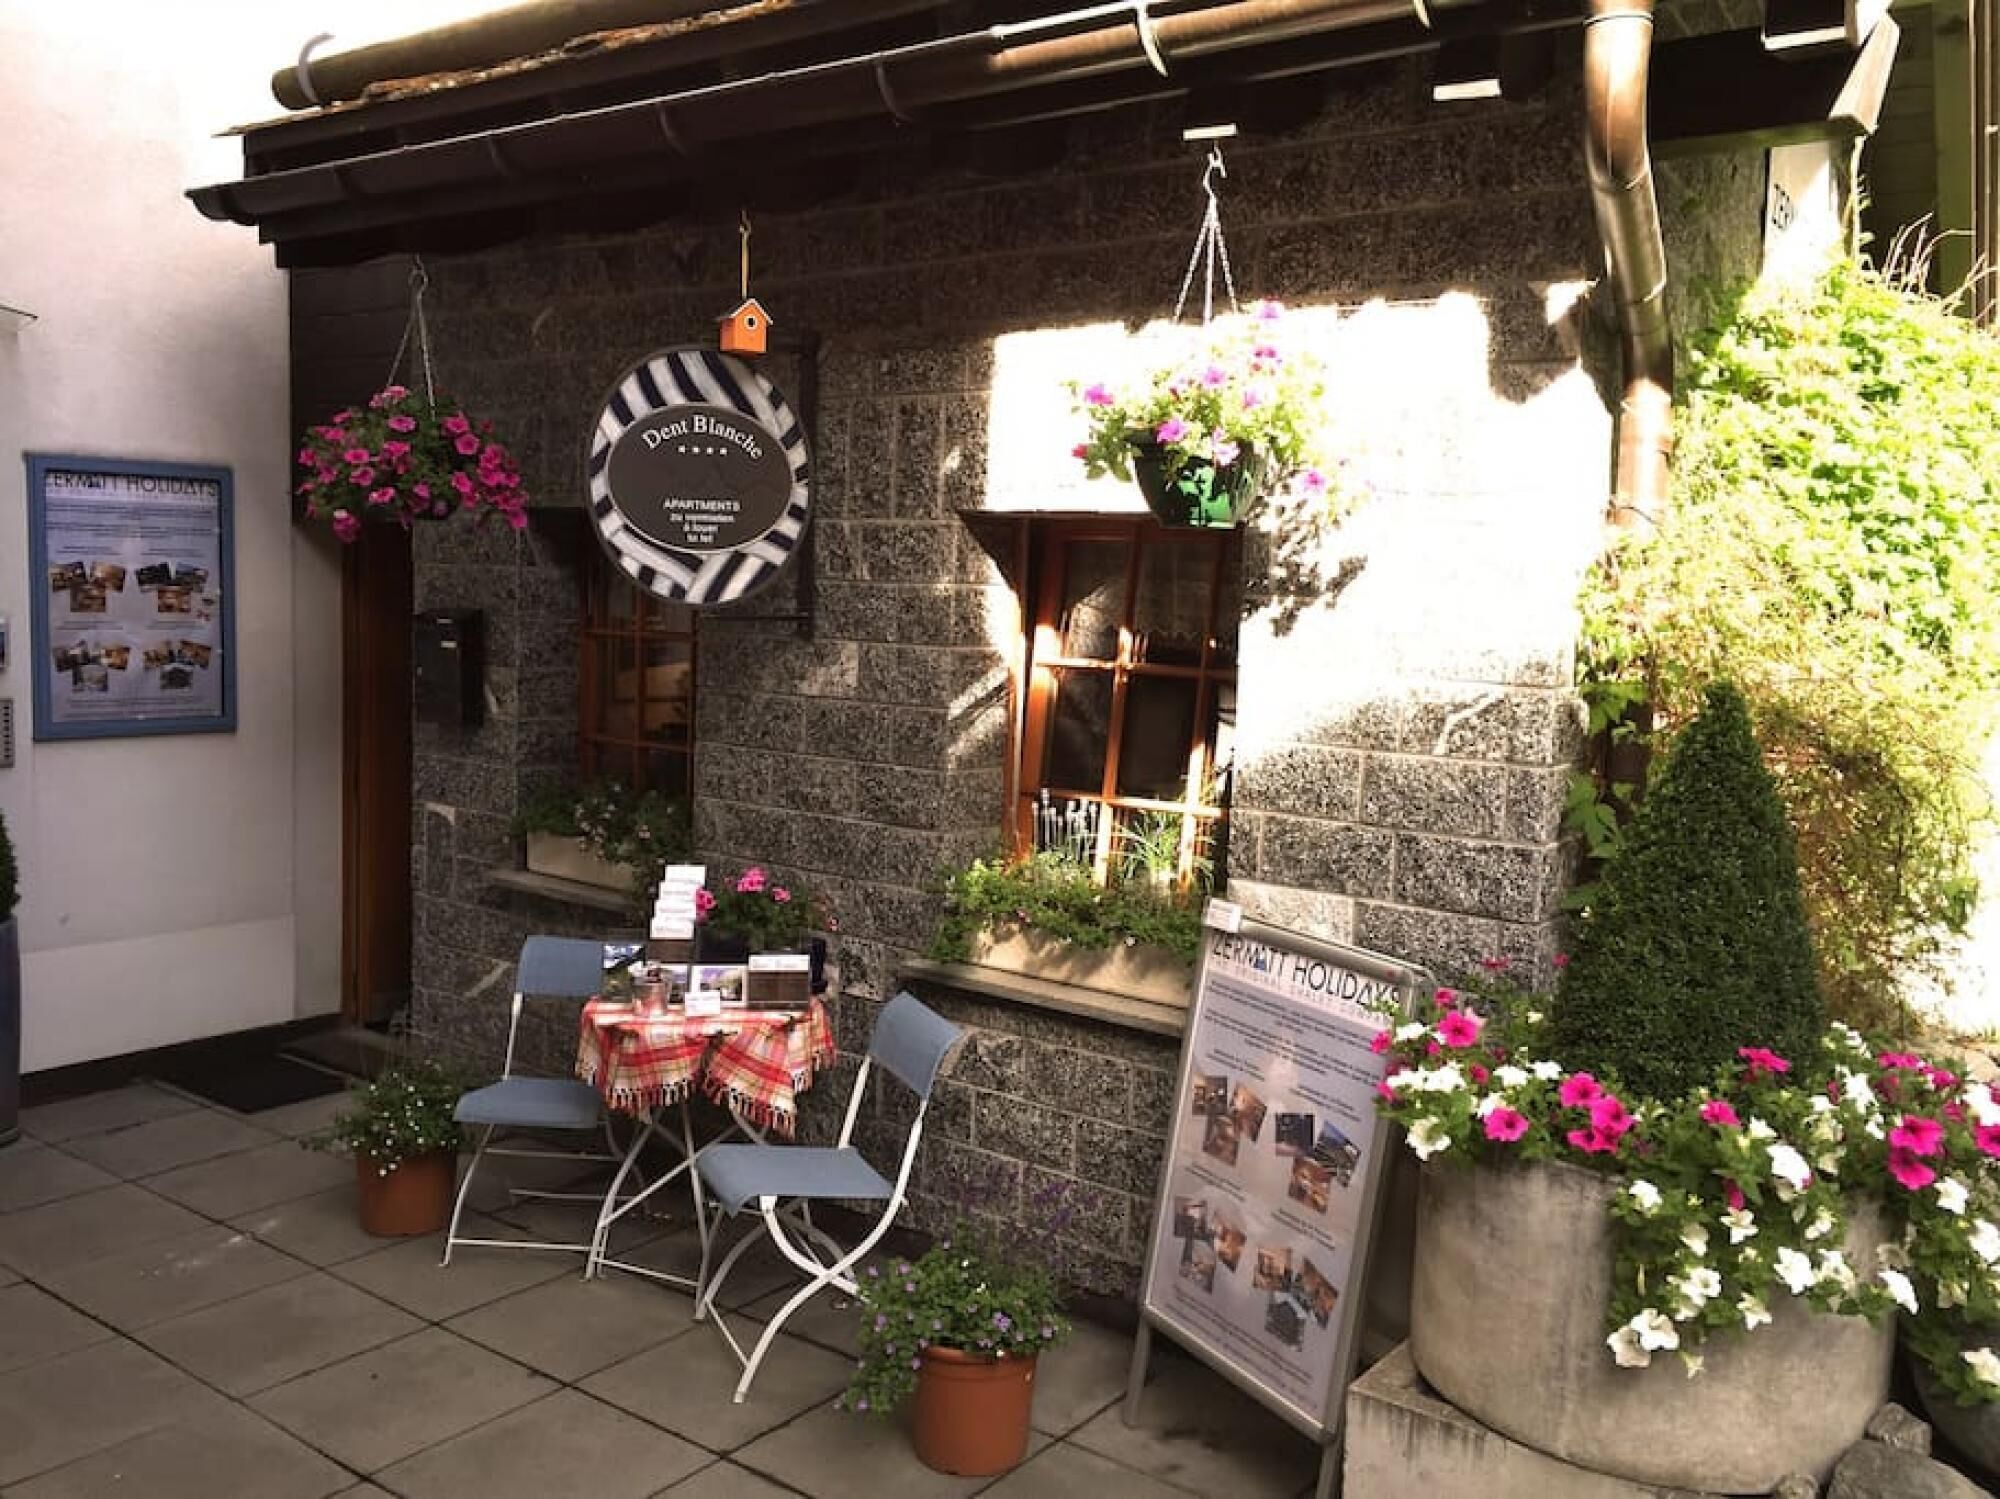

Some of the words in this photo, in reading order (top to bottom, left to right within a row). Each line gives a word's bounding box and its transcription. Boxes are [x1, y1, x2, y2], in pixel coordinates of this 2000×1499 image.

[642, 420, 688, 449] Dent
[693, 415, 762, 459] Blanche
[663, 499, 741, 512] APARTMENTS
[1212, 934, 1289, 977] ZERMATT
[1292, 954, 1400, 1006] HOLIDAYS
